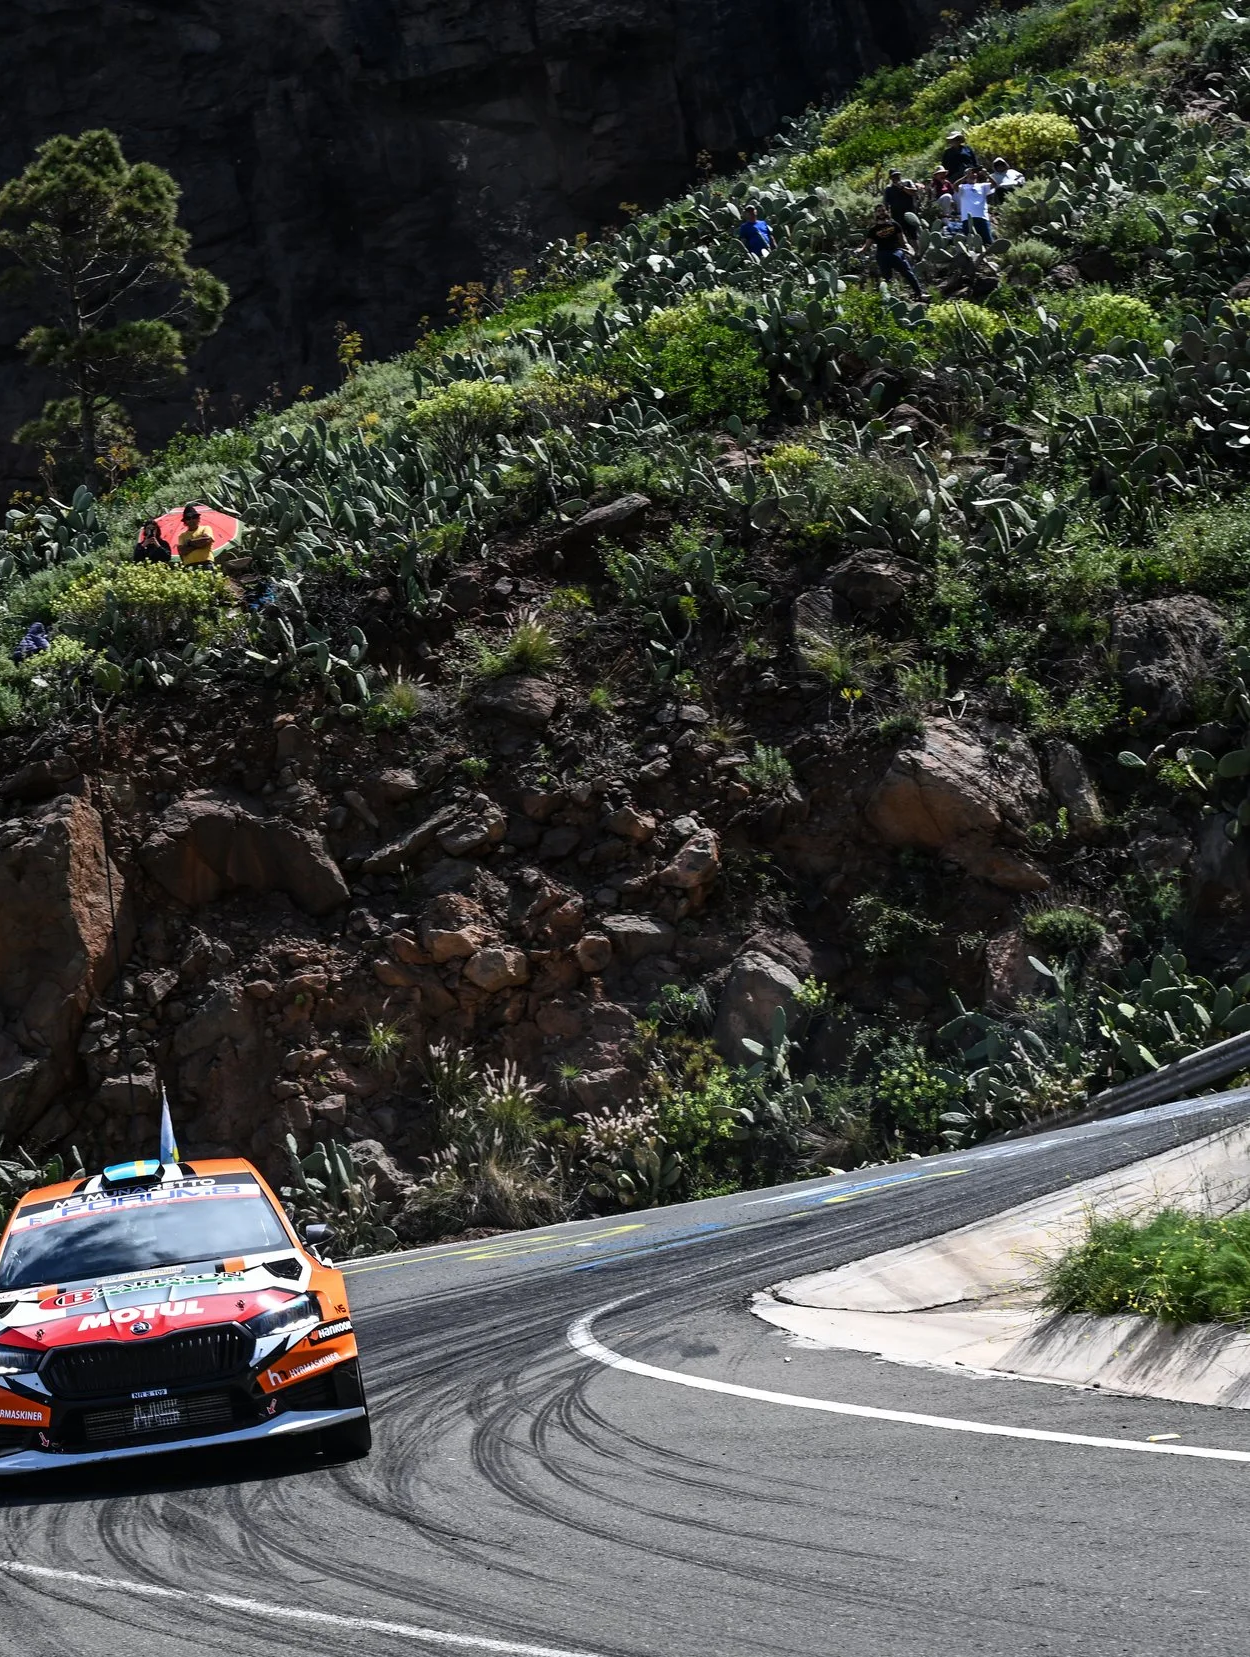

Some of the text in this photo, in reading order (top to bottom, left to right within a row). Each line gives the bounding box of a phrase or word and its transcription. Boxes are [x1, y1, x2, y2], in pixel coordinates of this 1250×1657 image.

[62, 1186, 240, 1217] FORUM8
[78, 1301, 205, 1332] MOTUL
[289, 1352, 342, 1379] HYRMASKINER
